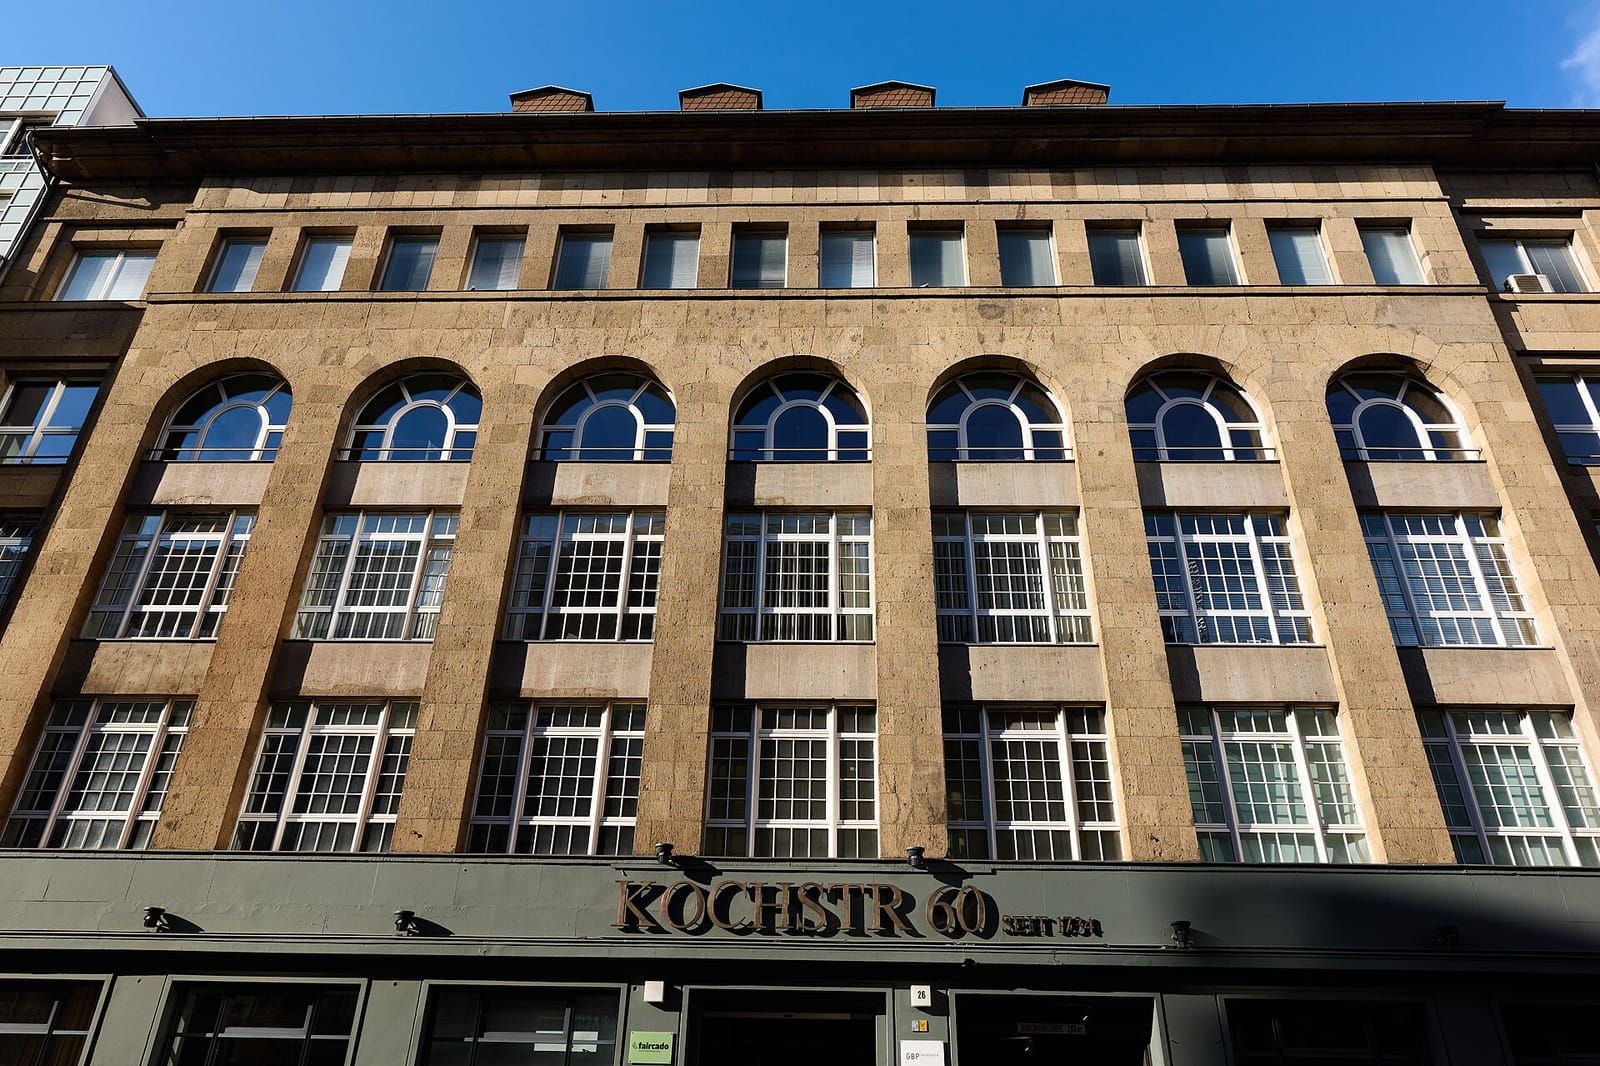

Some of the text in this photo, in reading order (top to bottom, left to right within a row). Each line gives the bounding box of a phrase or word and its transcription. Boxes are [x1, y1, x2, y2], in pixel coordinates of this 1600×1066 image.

[611, 880, 912, 932] KOCHSTR
[926, 884, 986, 933] 60
[1002, 914, 1050, 934] SEIT
[917, 990, 926, 999] 26
[638, 1041, 669, 1050] faircado
[905, 1052, 920, 1060] GBP
